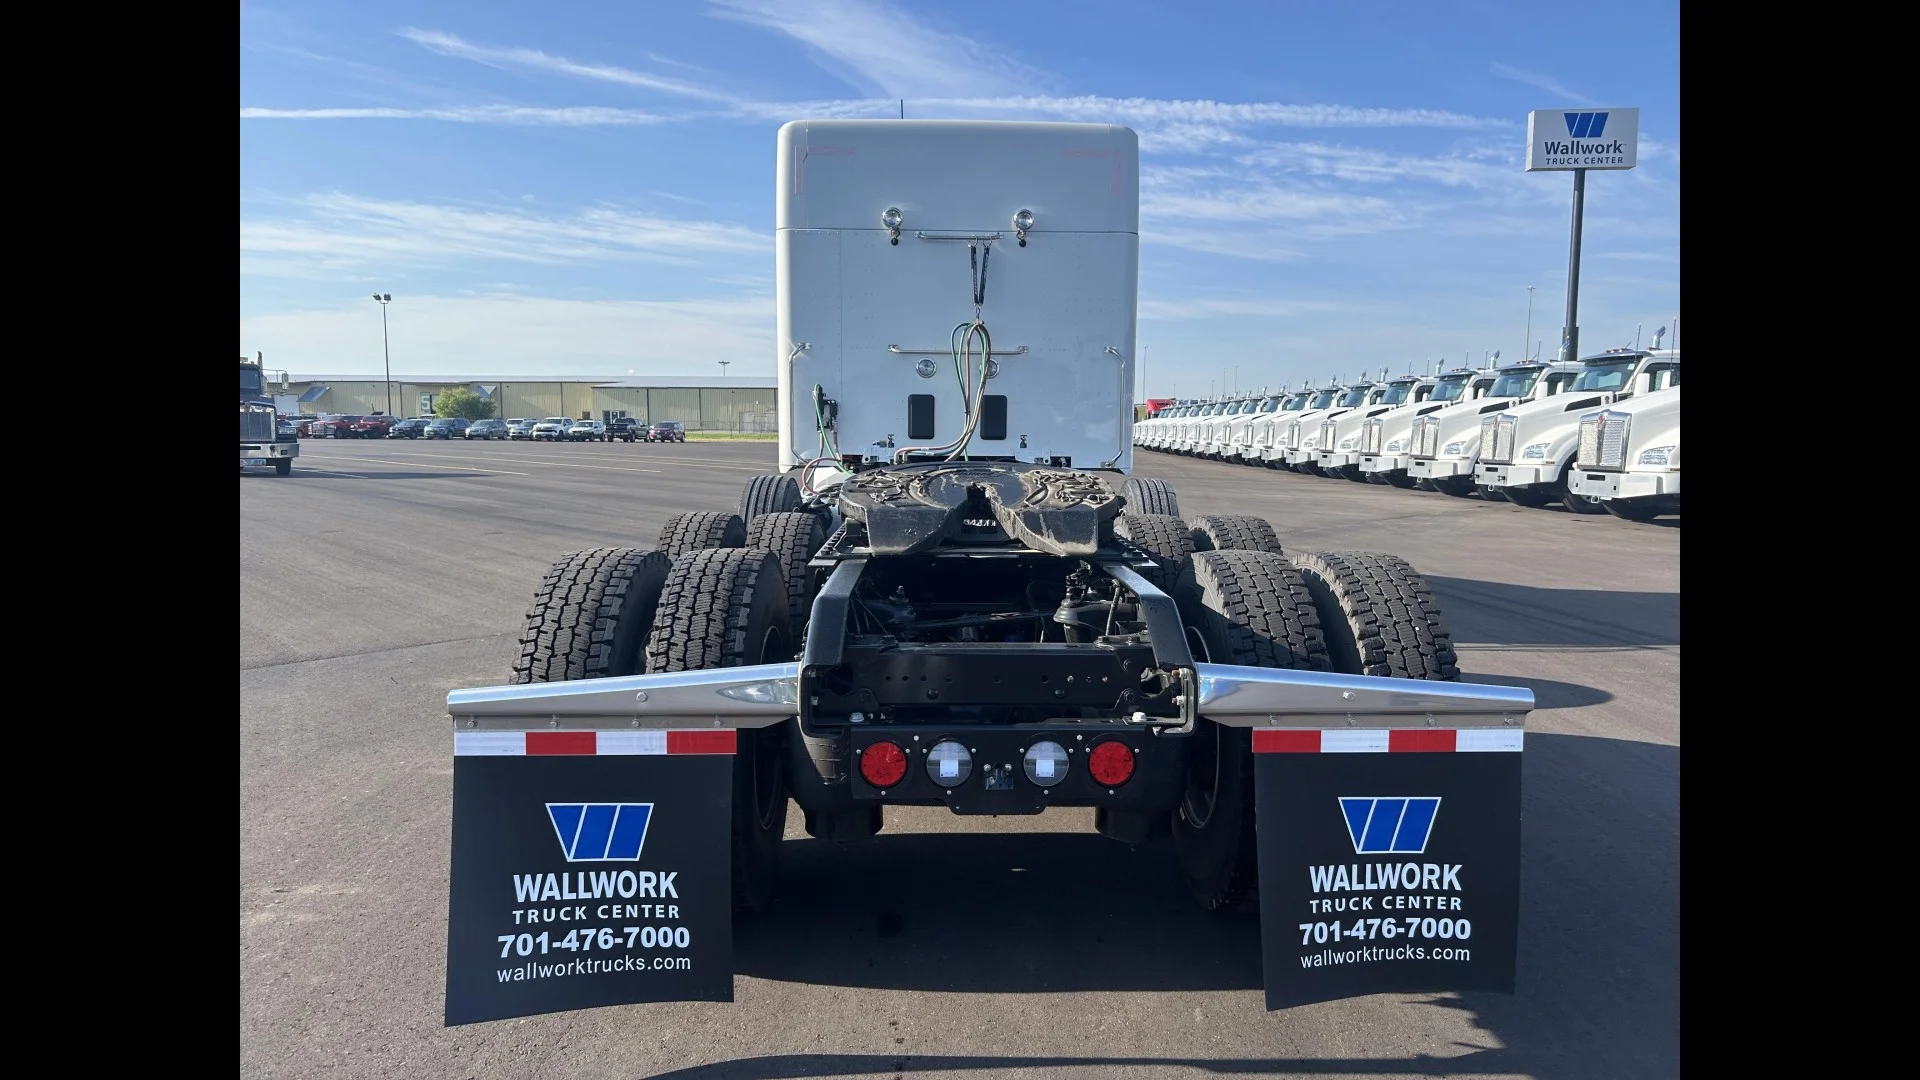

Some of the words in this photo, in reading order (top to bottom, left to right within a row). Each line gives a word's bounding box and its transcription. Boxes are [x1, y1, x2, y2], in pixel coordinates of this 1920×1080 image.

[1544, 139, 1623, 155] Wallwork
[1546, 157, 1580, 165] TRUCK
[1583, 156, 1624, 165] CENTER
[512, 870, 679, 903] WALLWORK
[1309, 862, 1463, 893] WALLWORK
[512, 906, 587, 925] TRUCK
[597, 904, 680, 920] CENTER
[1309, 896, 1373, 914] TRUCK
[1381, 895, 1462, 911] CENTER
[497, 926, 690, 959] 701-476-7000
[1299, 917, 1472, 946] 701-476-7000
[497, 954, 691, 983] wallworktrucks.com
[1300, 944, 1470, 969] wallworktrucks.com
